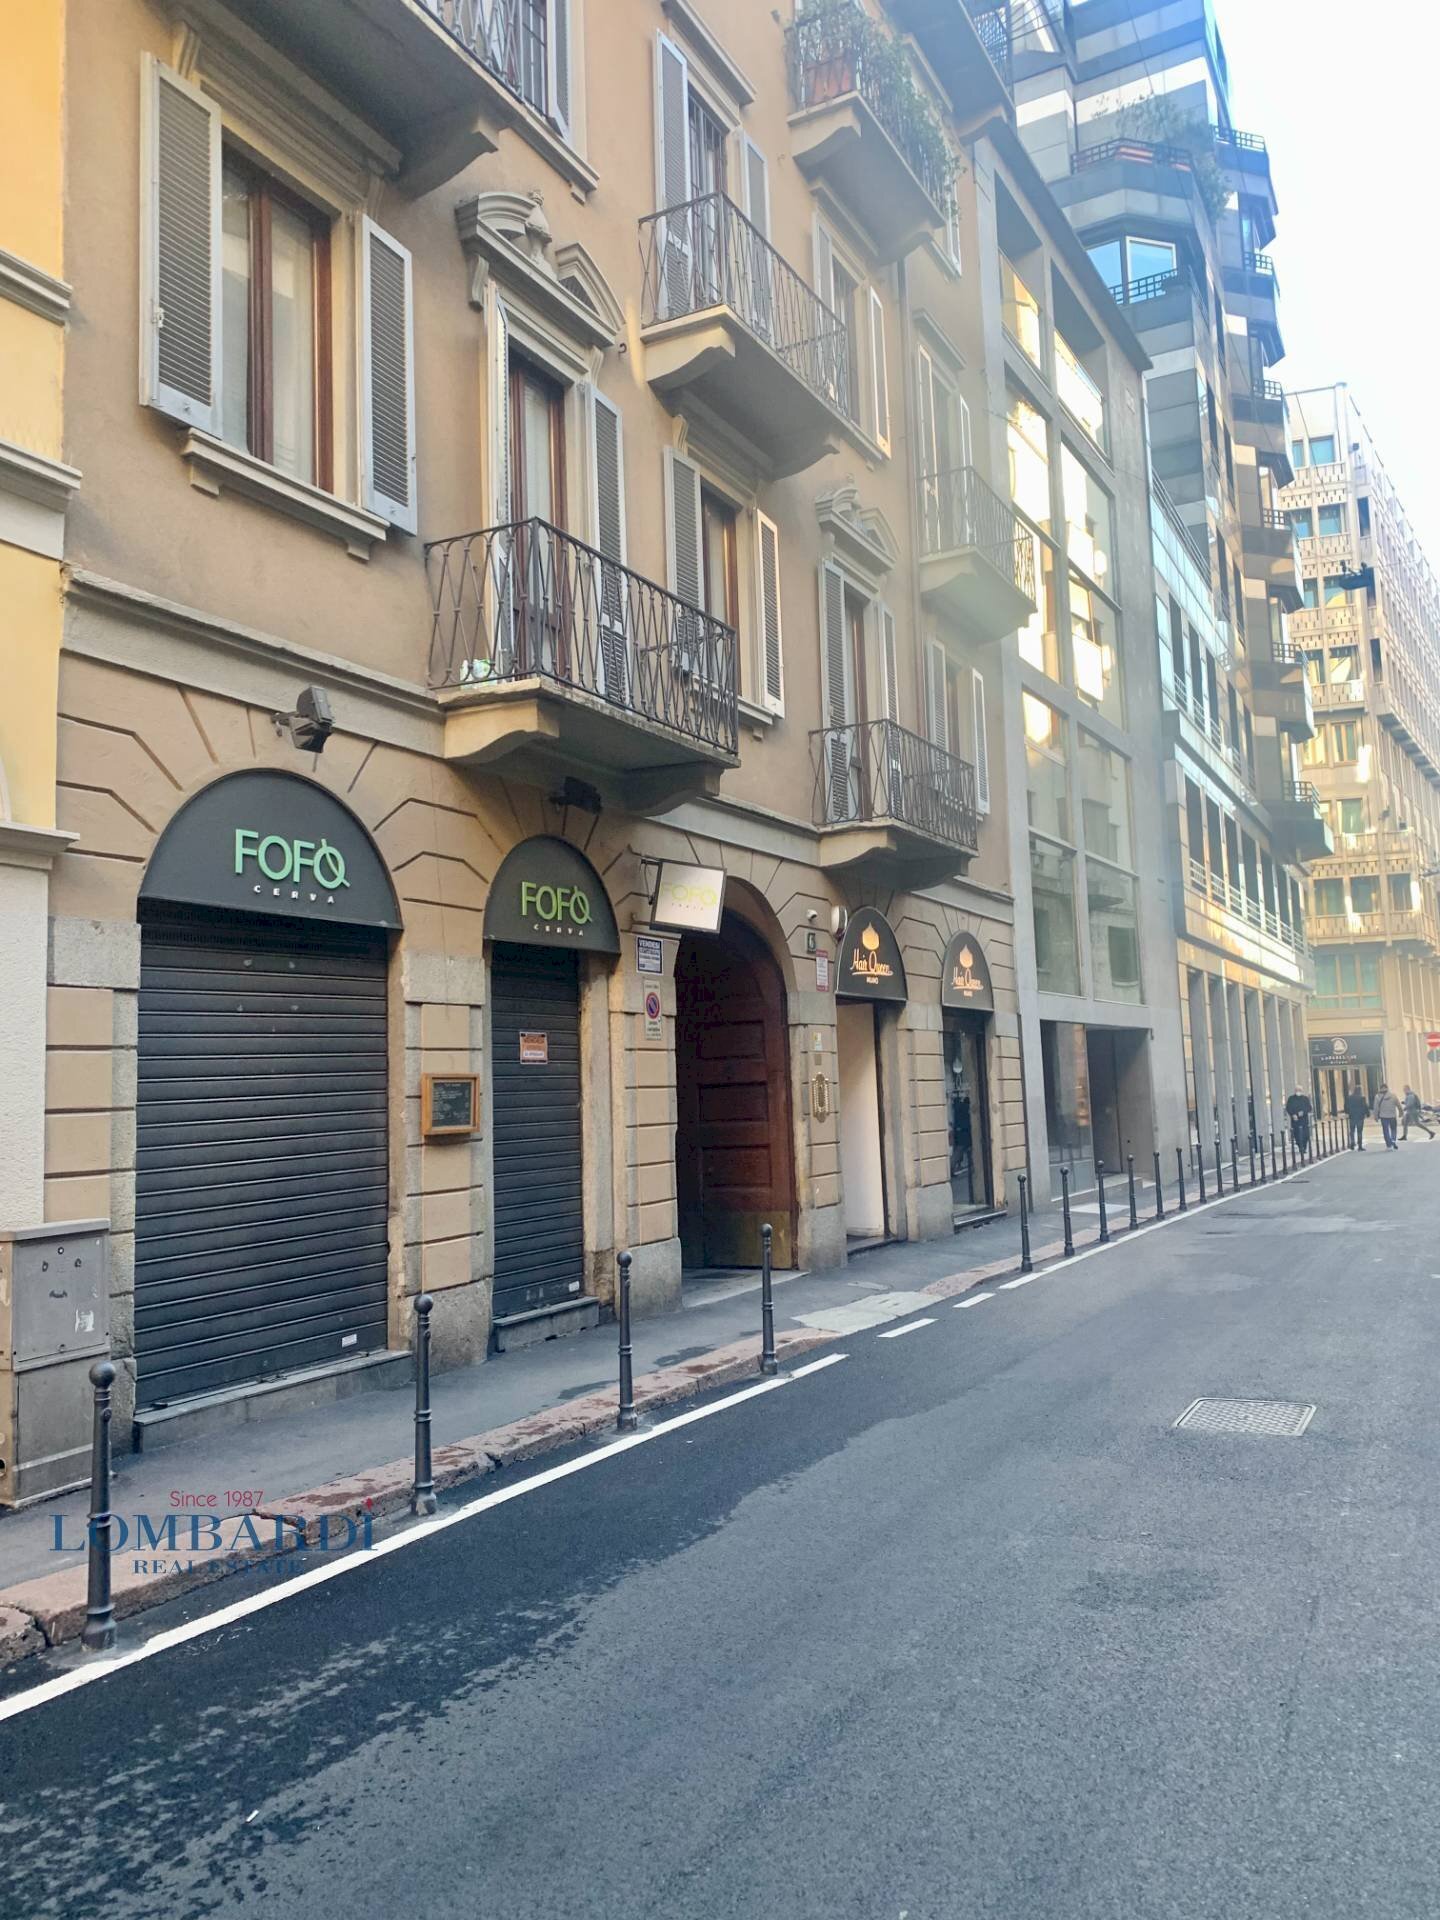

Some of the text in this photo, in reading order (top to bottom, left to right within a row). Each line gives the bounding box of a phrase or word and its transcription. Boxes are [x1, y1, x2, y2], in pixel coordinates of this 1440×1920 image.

[253, 884, 335, 904] CERVA
[533, 923, 584, 937] CERVA
[850, 948, 868, 971] Hair
